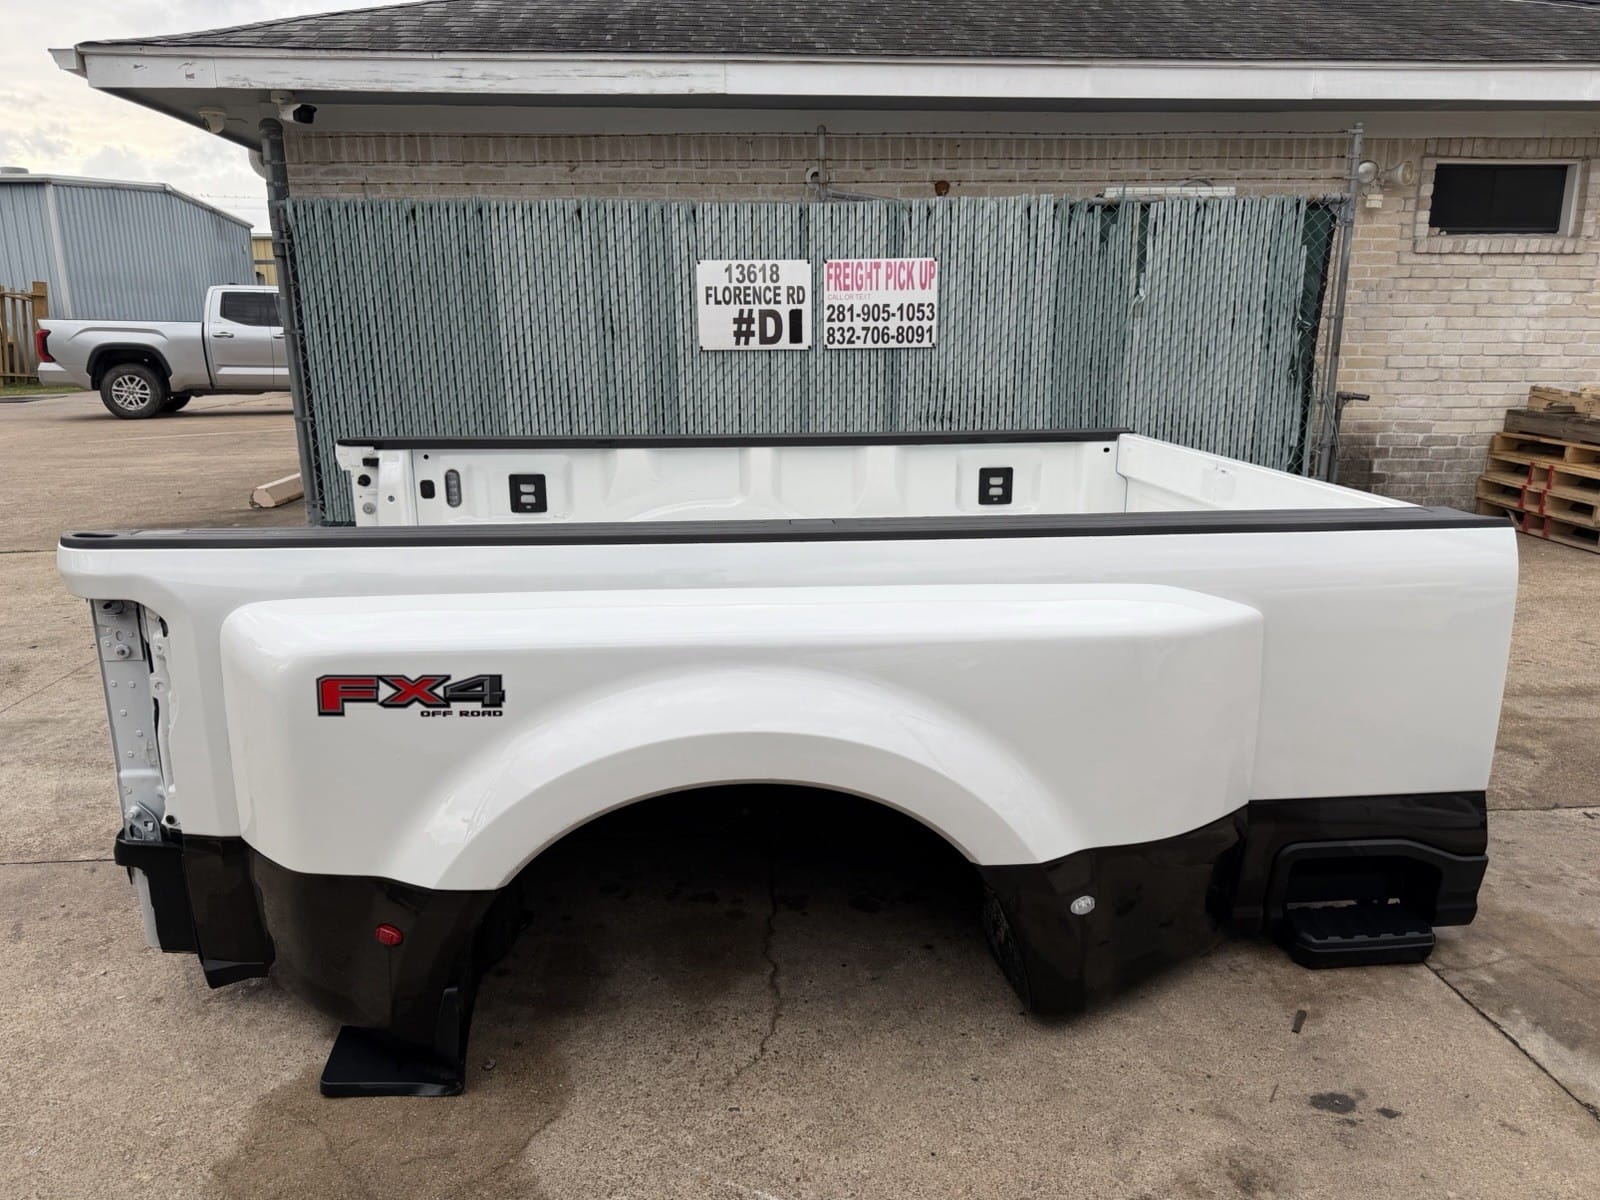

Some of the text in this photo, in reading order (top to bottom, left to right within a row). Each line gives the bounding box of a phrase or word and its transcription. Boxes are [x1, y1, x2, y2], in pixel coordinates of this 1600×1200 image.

[724, 263, 780, 284] 13618
[826, 260, 937, 292] FREIGHT PICK UP
[705, 285, 806, 306] FLORENCE RD
[826, 302, 936, 323] 281-905-1053
[826, 325, 934, 345] 832-706-8091
[316, 674, 506, 717] FX4
